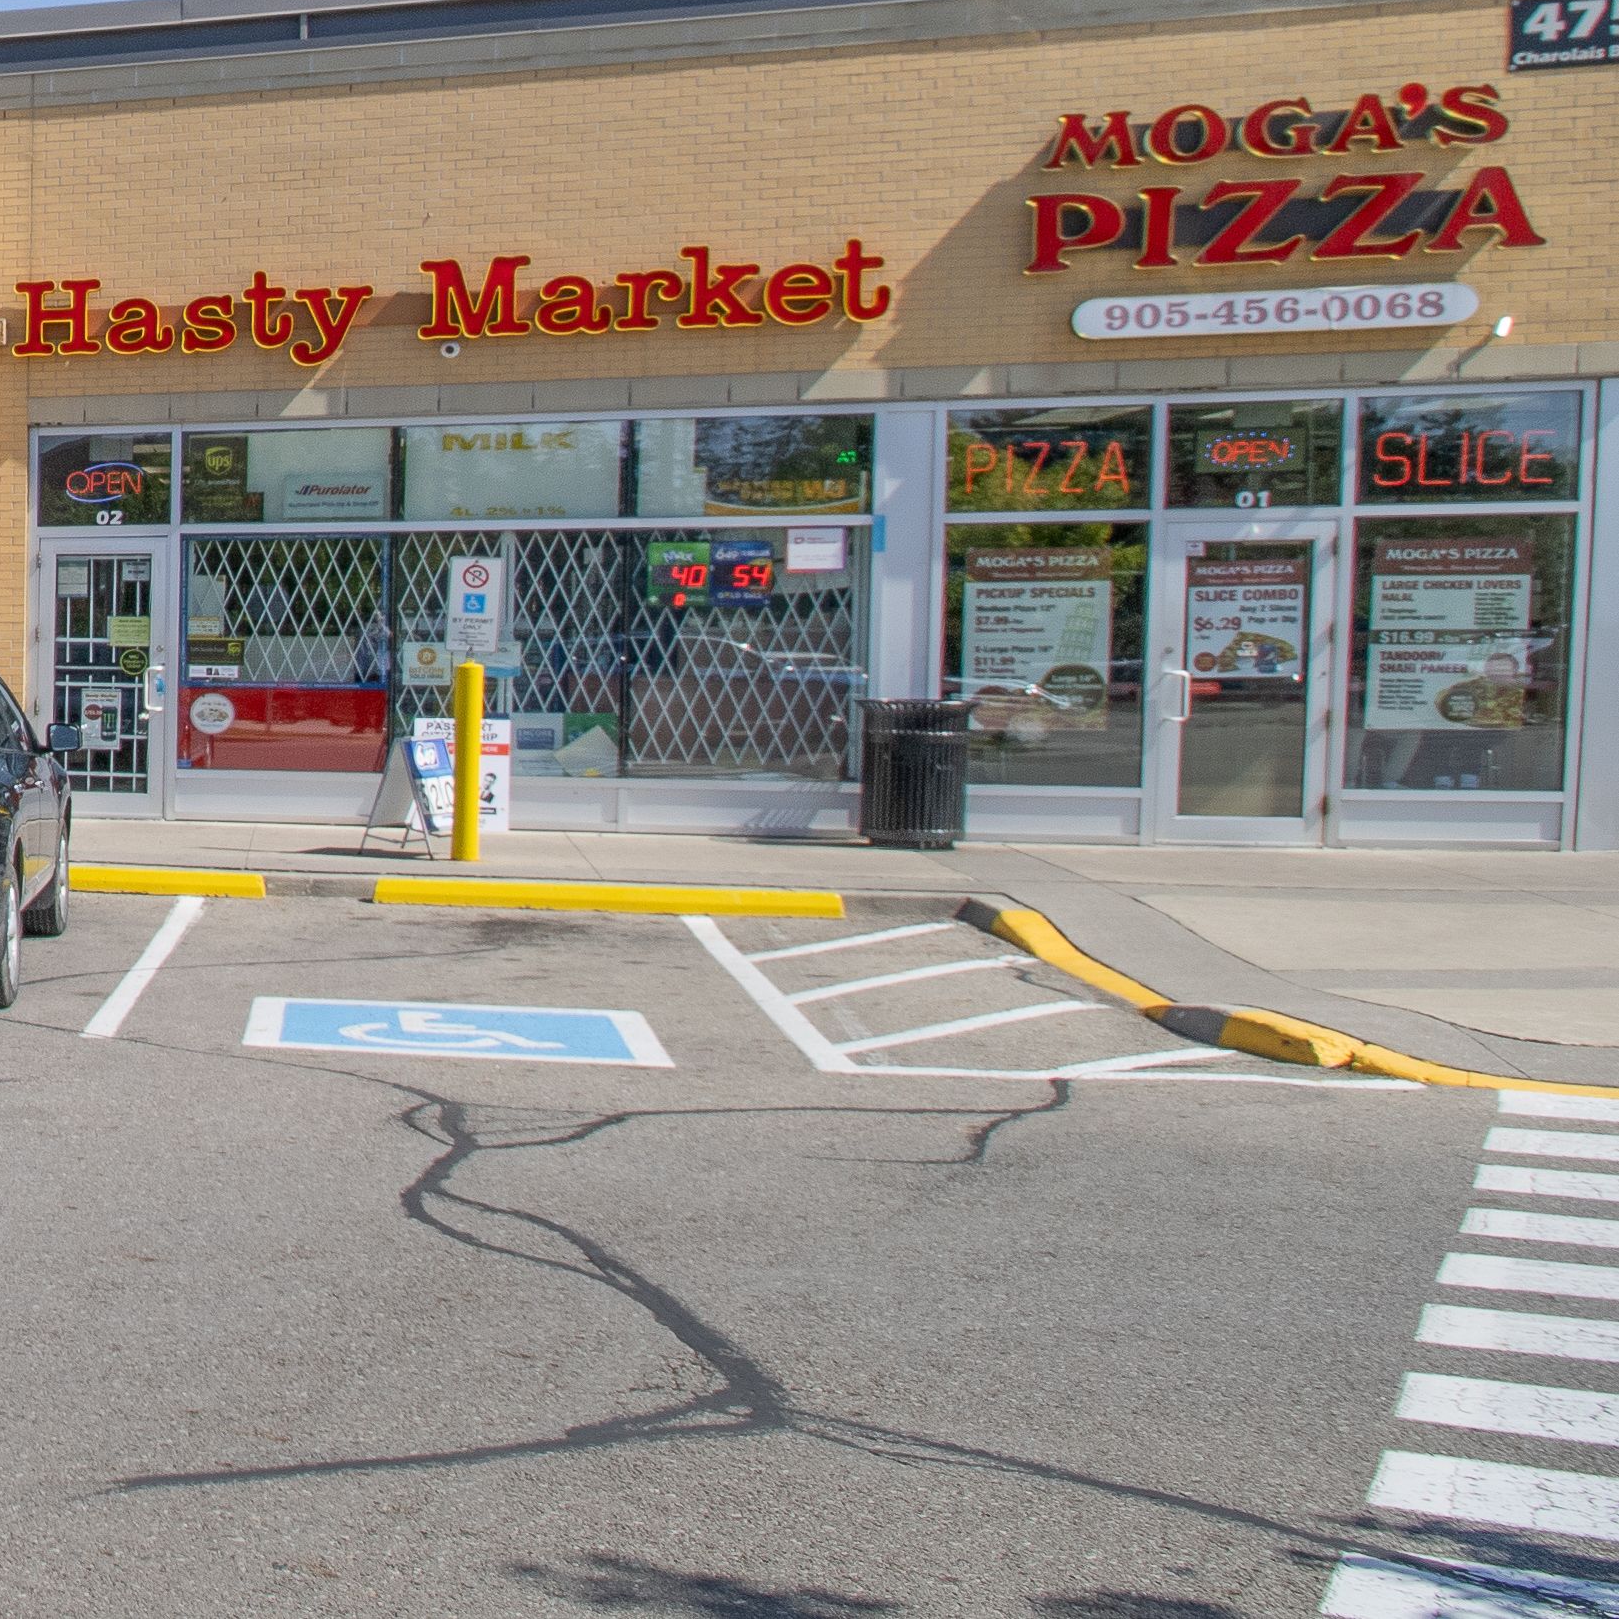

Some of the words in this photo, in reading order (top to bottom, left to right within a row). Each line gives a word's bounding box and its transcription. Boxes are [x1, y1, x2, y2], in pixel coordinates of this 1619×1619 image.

[1512, 46, 1607, 65] Charolais
[1042, 83, 1510, 170] MOGA'S
[1024, 165, 1548, 275] PIZZA
[12, 270, 374, 367] Hasty
[417, 238, 892, 341] Market
[1103, 290, 1446, 333] 905-456-0068
[442, 431, 577, 452] MILK
[1211, 439, 1289, 465] OPEN
[1373, 430, 1556, 487] SLICE
[964, 441, 1132, 496] PIZZA
[66, 470, 142, 494] OPEN
[309, 484, 371, 495] Purolator
[1234, 491, 1270, 508] 01
[96, 510, 123, 525] 02
[1048, 554, 1099, 566] PIZZA
[1464, 547, 1520, 559] PIZZA
[671, 564, 708, 588] 40
[732, 564, 772, 588] 54
[1252, 565, 1295, 574] PIZZA
[975, 587, 1025, 598] PICKUP
[1029, 587, 1095, 598] SPECIALS
[1381, 580, 1419, 590] LARGE
[1477, 580, 1522, 589] LOVERS
[1194, 589, 1238, 602] SLICE
[1242, 588, 1299, 601] COMBO
[1193, 616, 1242, 631] $6.29
[1379, 631, 1435, 643] $16.99
